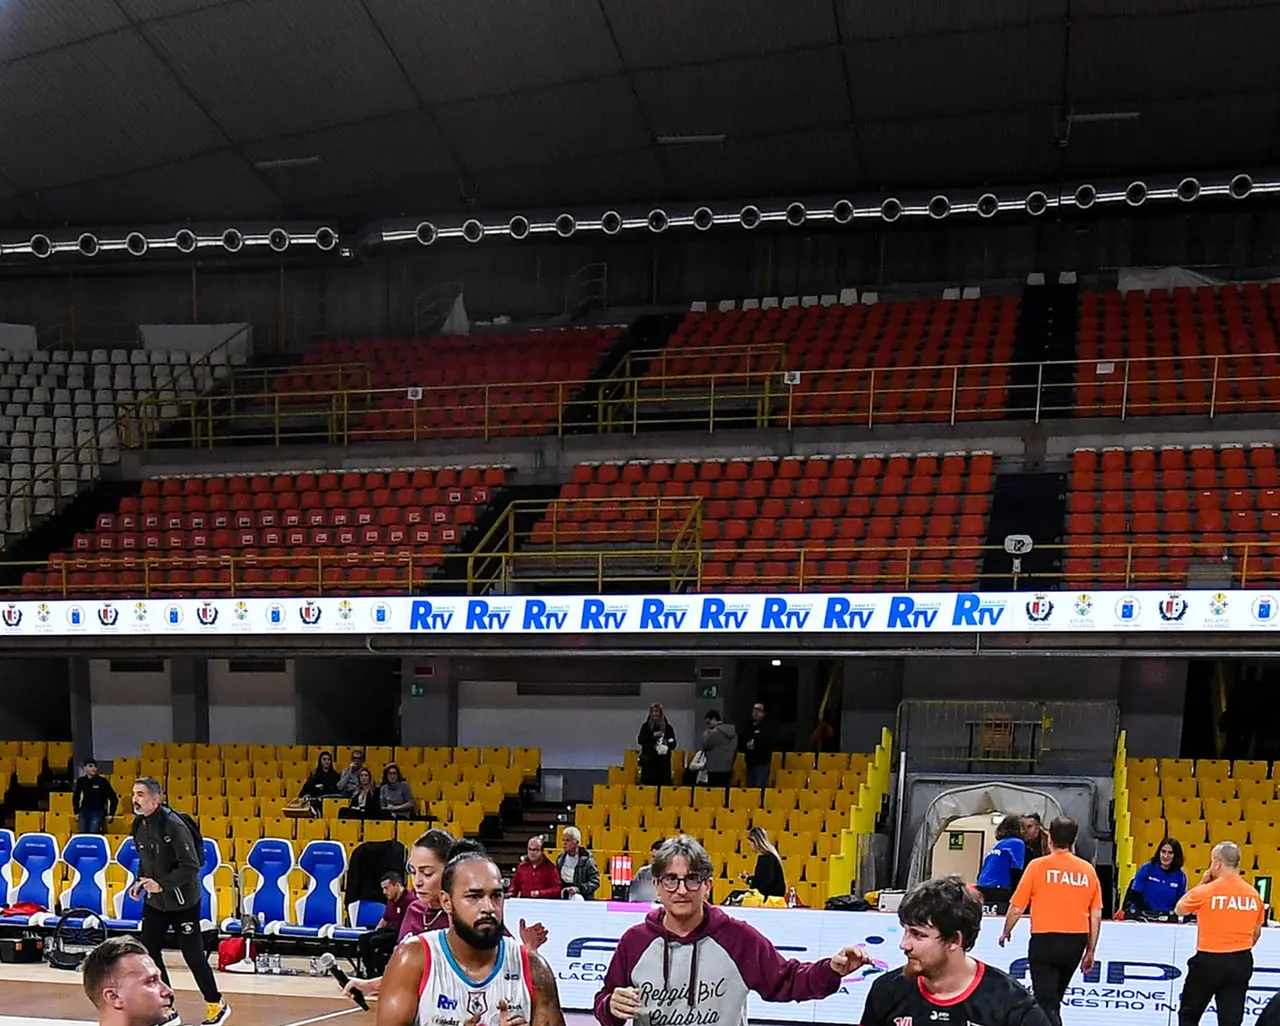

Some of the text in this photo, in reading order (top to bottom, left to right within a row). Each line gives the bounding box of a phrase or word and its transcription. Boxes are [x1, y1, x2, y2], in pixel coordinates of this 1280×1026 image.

[1045, 869, 1090, 887] ITALIA
[1210, 895, 1259, 911] ITALIA
[648, 1009, 721, 1026] Calabria
